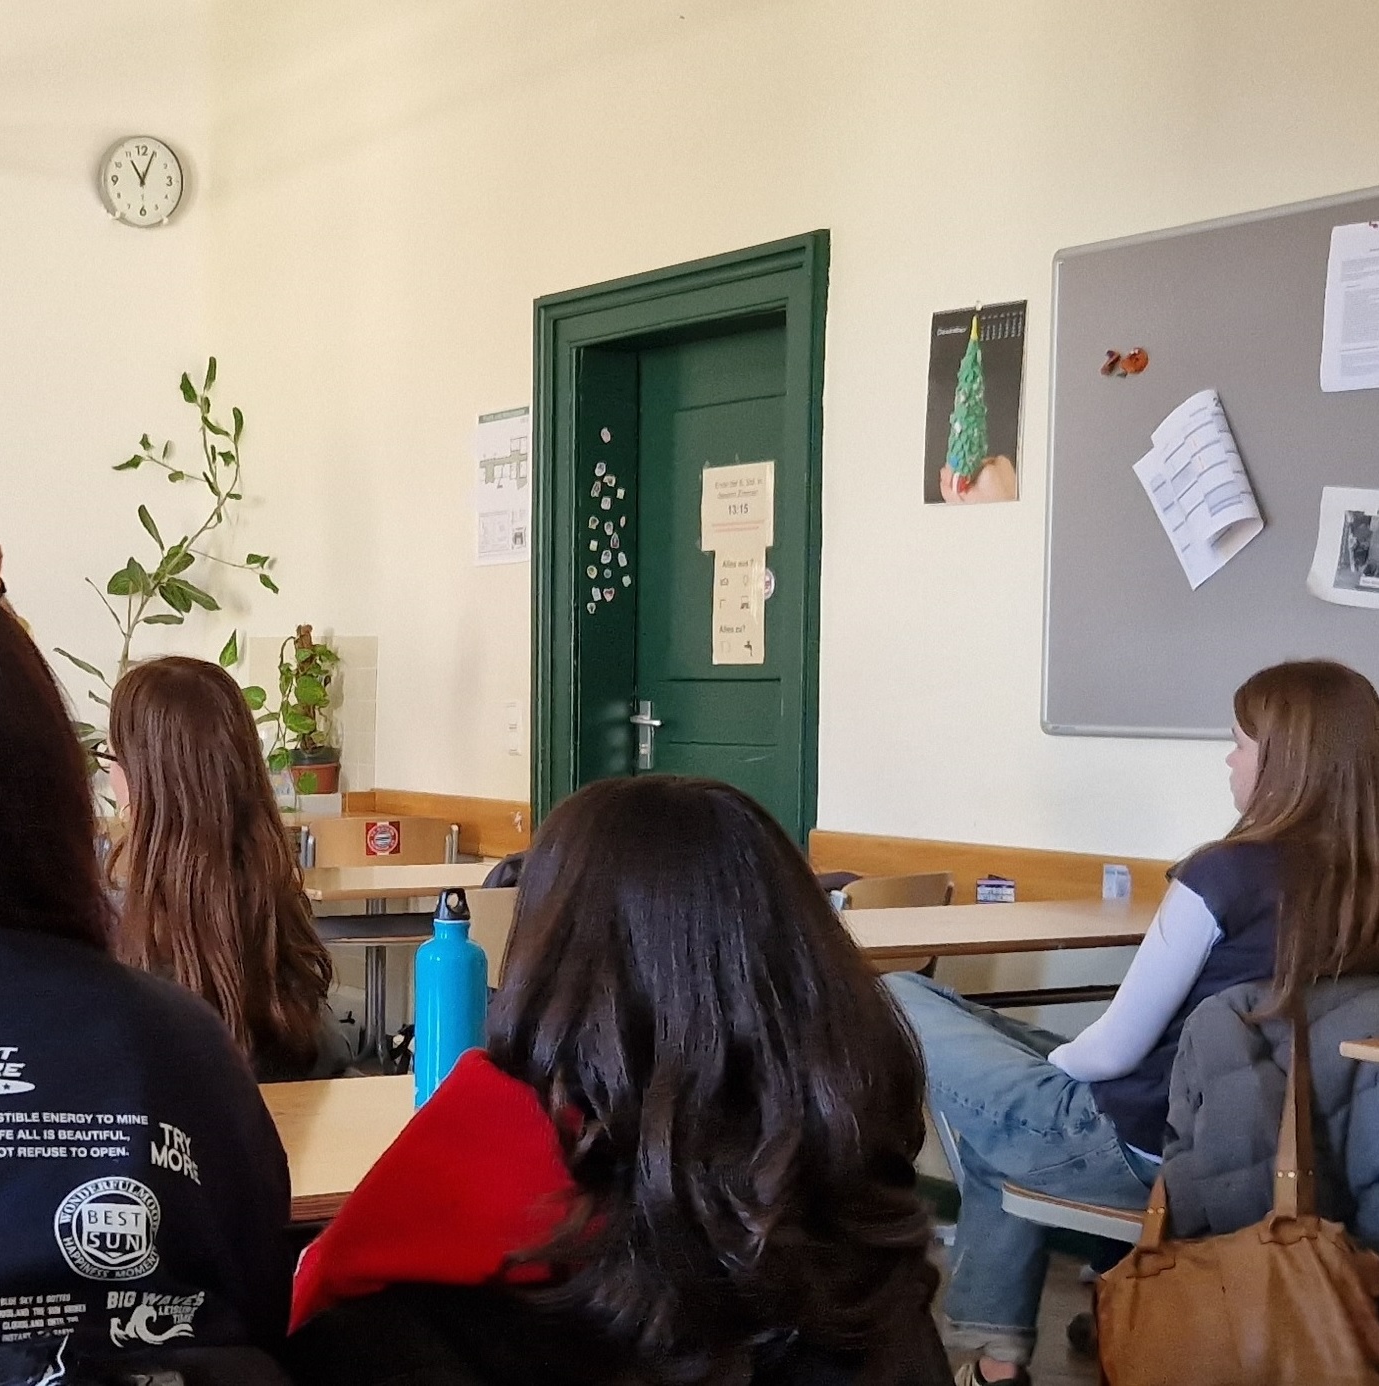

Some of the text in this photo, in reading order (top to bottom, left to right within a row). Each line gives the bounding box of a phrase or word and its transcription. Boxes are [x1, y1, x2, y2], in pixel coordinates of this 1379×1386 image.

[134, 145, 148, 156] 12
[111, 175, 119, 186] 9
[166, 176, 173, 187] 3
[139, 205, 147, 216] 6
[43, 1112, 93, 1124] ENERGY
[96, 1114, 114, 1124] TO
[116, 1114, 149, 1125] MINE
[17, 1129, 41, 1141] ALL
[43, 1129, 55, 1140] IS
[58, 1130, 130, 1141] BEAUTIFUL,
[159, 1122, 191, 1156] TRY
[17, 1147, 68, 1158] REFUSE
[70, 1147, 88, 1158] TO
[90, 1146, 130, 1158] OPEN.
[87, 1210, 141, 1227] BEST
[88, 1232, 139, 1251] SUN
[63, 1237, 109, 1278] HAPPINESS
[106, 1291, 205, 1309] BIG WAVES
